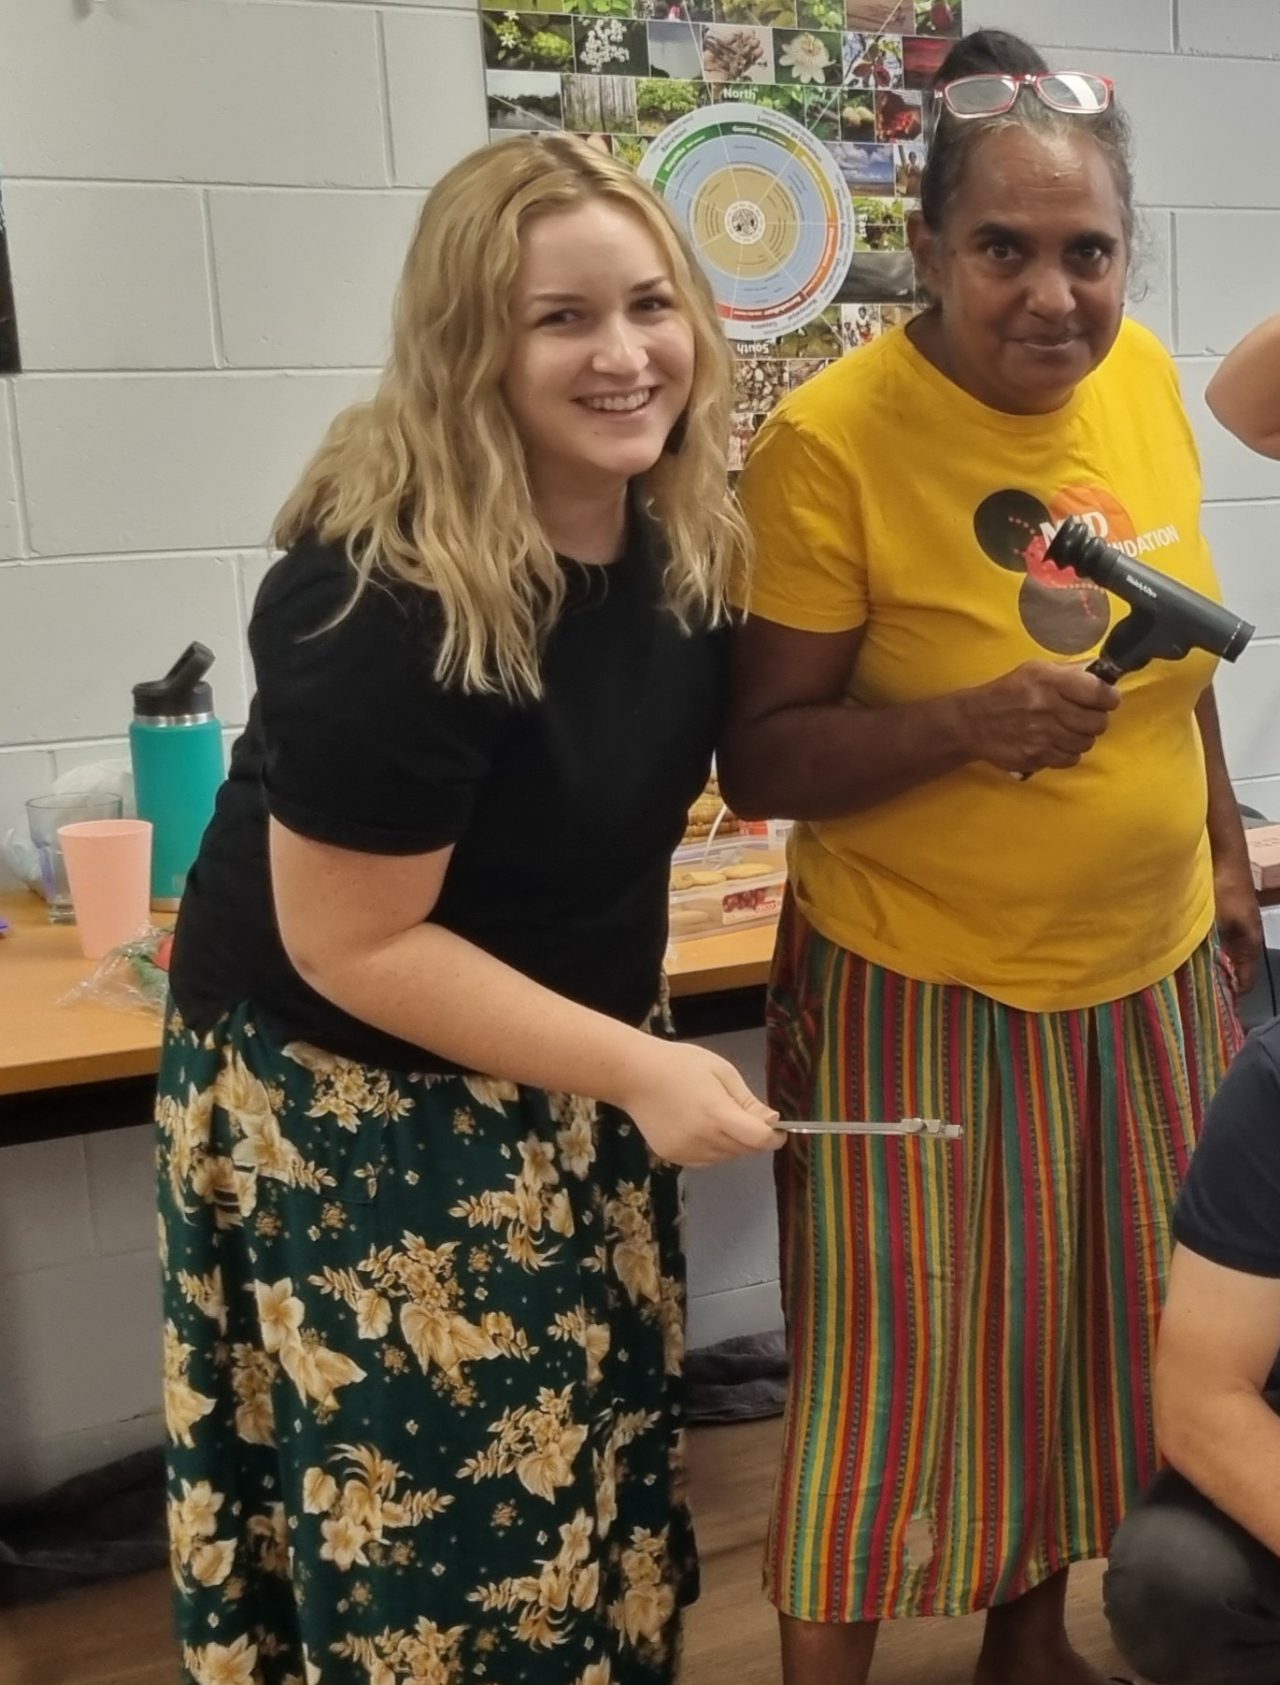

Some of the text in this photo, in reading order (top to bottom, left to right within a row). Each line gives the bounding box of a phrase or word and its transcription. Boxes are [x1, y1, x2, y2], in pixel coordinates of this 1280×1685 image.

[723, 87, 757, 101] North
[736, 343, 770, 354] South
[1039, 511, 1109, 549] MD
[1107, 525, 1179, 557] NDATION
